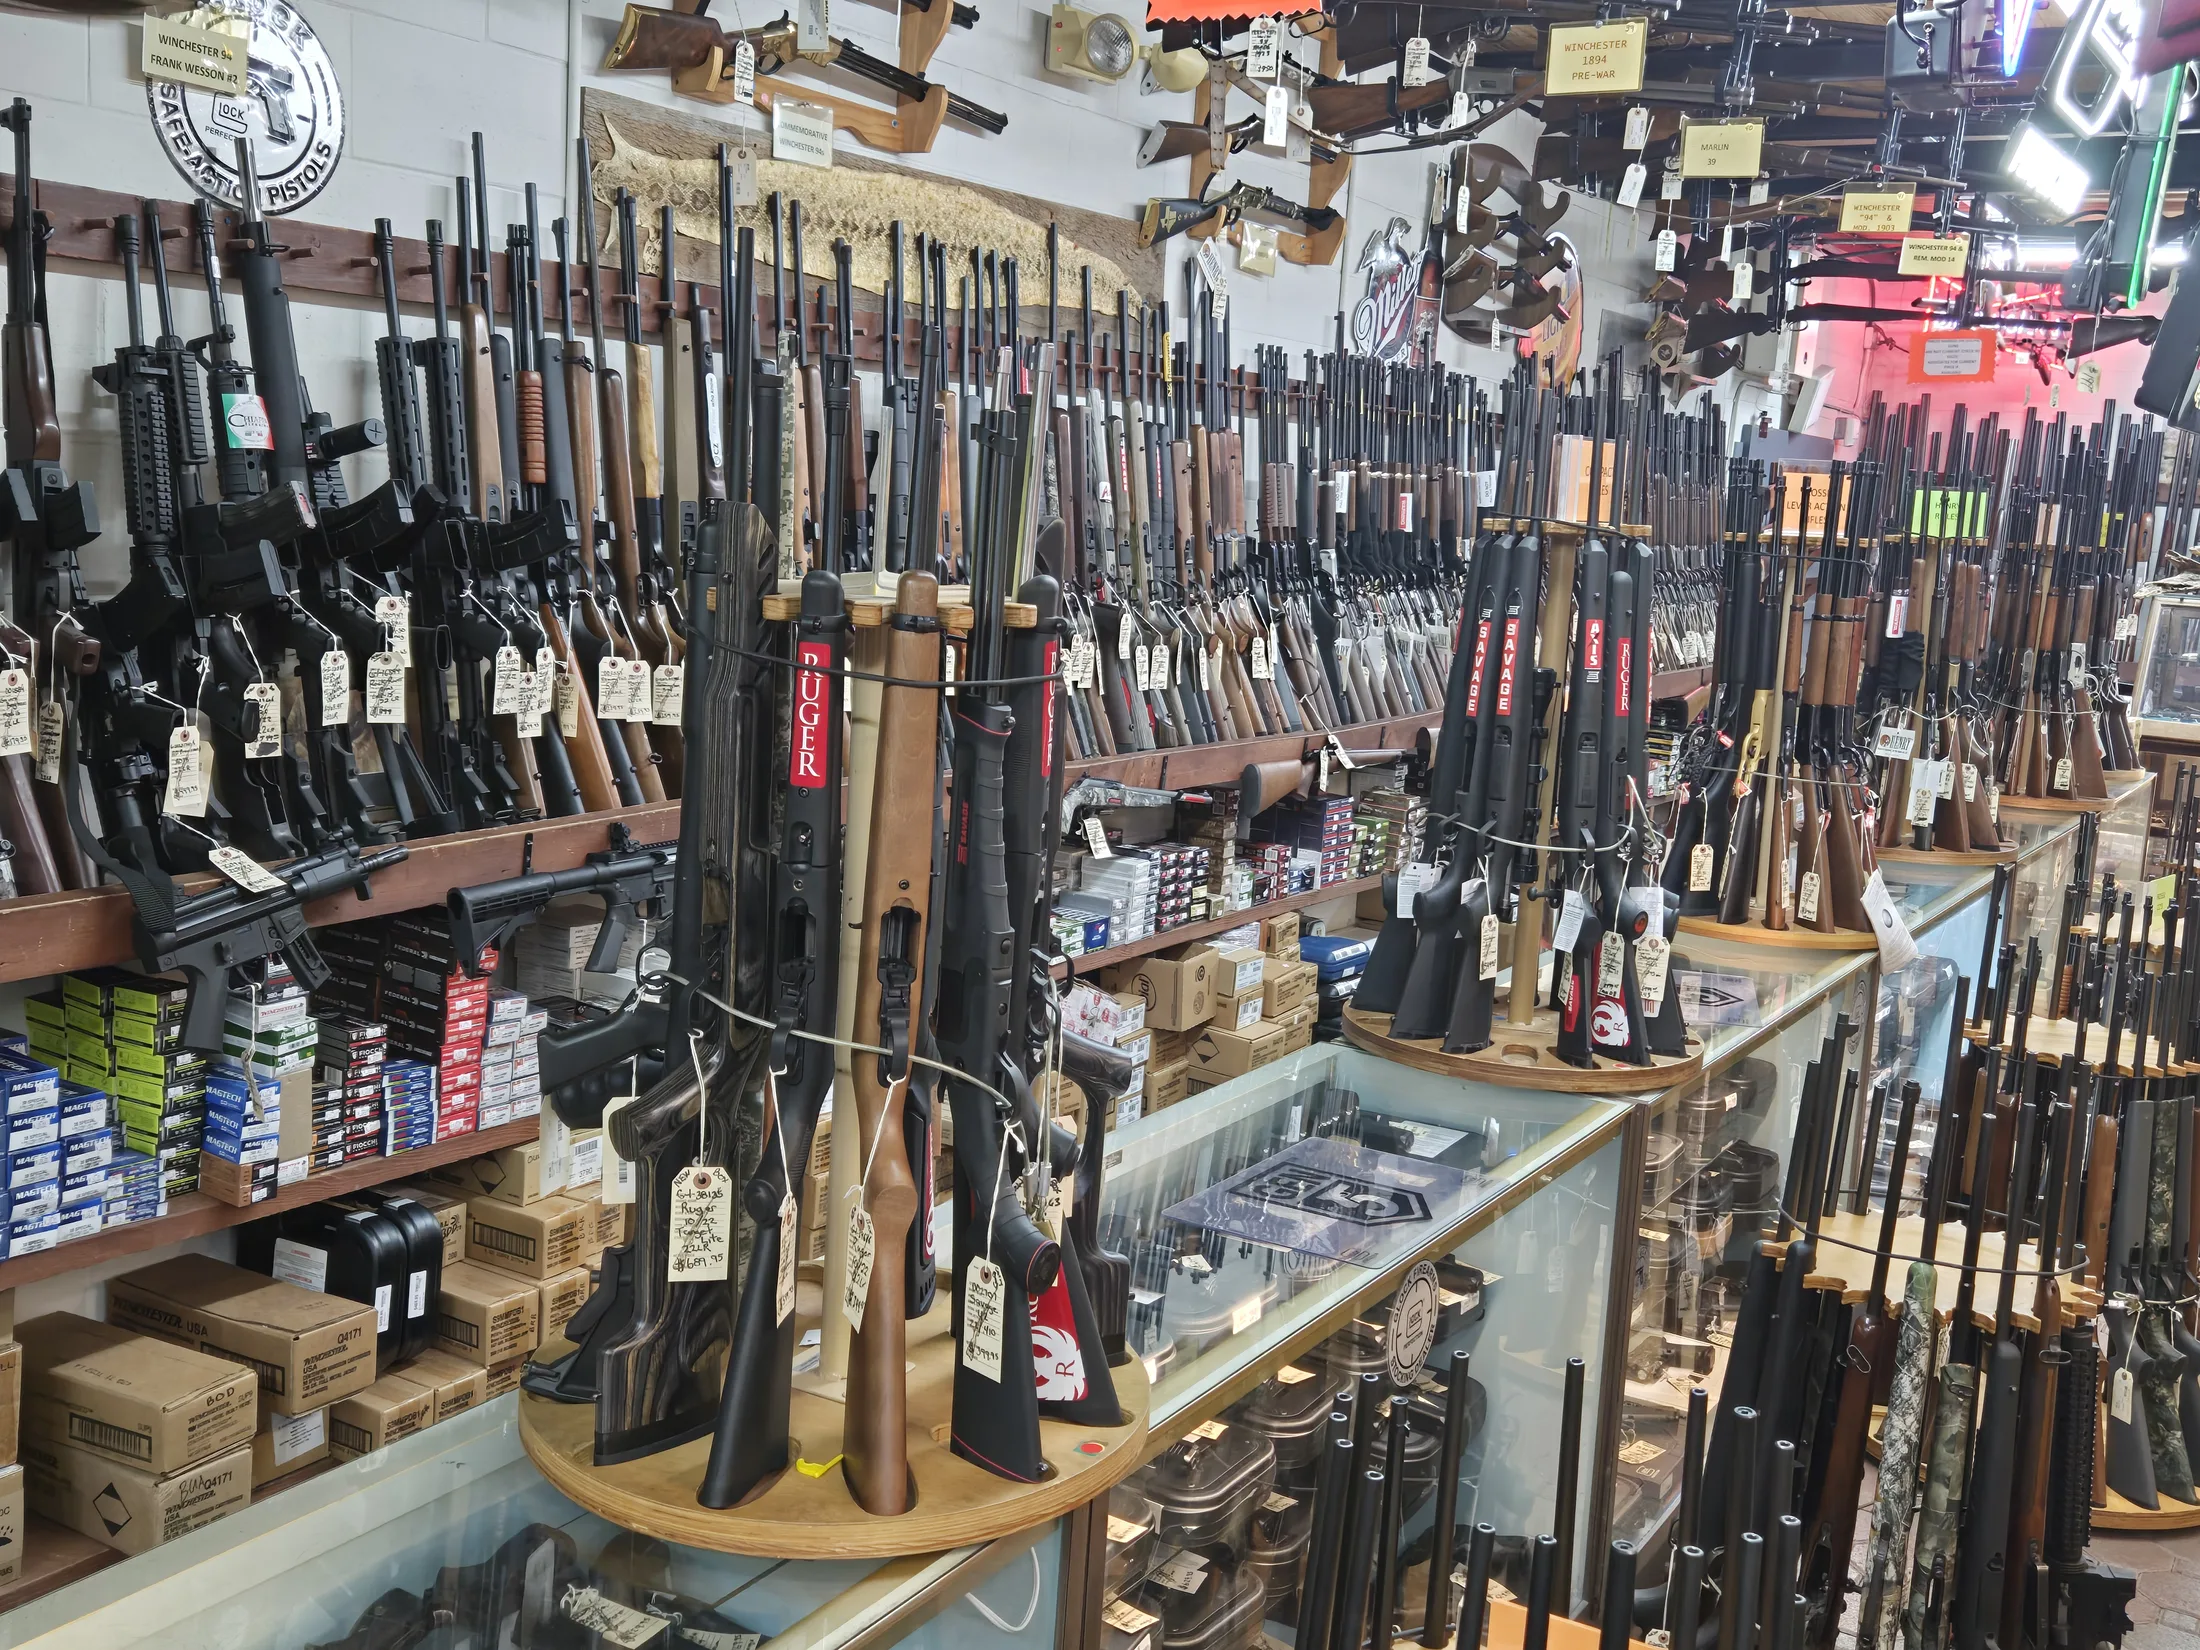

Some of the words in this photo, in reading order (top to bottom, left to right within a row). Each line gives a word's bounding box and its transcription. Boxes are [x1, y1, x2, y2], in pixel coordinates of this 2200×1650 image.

[158, 33, 219, 58] WINCHESTER
[221, 49, 233, 61] 94
[1564, 39, 1628, 52] WINCHESTER
[150, 54, 182, 71] FRANK
[184, 62, 225, 81] WESSON
[226, 73, 238, 84] #2
[1582, 55, 1607, 65] 1894
[1572, 69, 1616, 81] PRE-WAR
[779, 120, 828, 141] OMMEMORATIVE
[779, 136, 814, 153] WINCHESTER
[1701, 143, 1729, 151] MARLIN
[1708, 157, 1717, 166] 39
[267, 140, 332, 206] PISTOLS
[1853, 204, 1901, 212] WINCHESTER
[1354, 256, 1423, 358] Miller
[1934, 512, 1958, 520] RLES
[1588, 622, 1601, 667] AXIS
[1468, 626, 1488, 712] SAVAGE
[1498, 623, 1517, 710] SAVAGE
[1620, 643, 1630, 711] RUGER
[798, 652, 824, 777] RUGER
[1890, 735, 1911, 751] HENRY
[394, 943, 420, 957] FEDERAL
[384, 990, 411, 1003] FEDERAL
[381, 1013, 408, 1026] FEDERAL
[205, 1085, 242, 1103] MAGTECH
[208, 1109, 239, 1130] MAGTECH
[205, 1134, 238, 1155] MAGTECH
[352, 1138, 378, 1150] FIOCCHI
[674, 1170, 690, 1187] NEW
[713, 1169, 729, 1183] BOX
[681, 1202, 717, 1216] Ruger
[1393, 1279, 1413, 1323] GLOCK
[1412, 1263, 1438, 1292] FIREARMS
[113, 1297, 183, 1330] WINCHESTER
[186, 1320, 209, 1337] USA
[337, 1327, 362, 1344] Q4171
[1390, 1355, 1414, 1383] STOCKING
[1414, 1323, 1435, 1374] DEALER
[303, 1364, 318, 1374] USA
[1056, 1360, 1076, 1378] R
[206, 1387, 235, 1407] BOD
[204, 1471, 232, 1490] Q4171
[164, 1512, 180, 1524] USA
